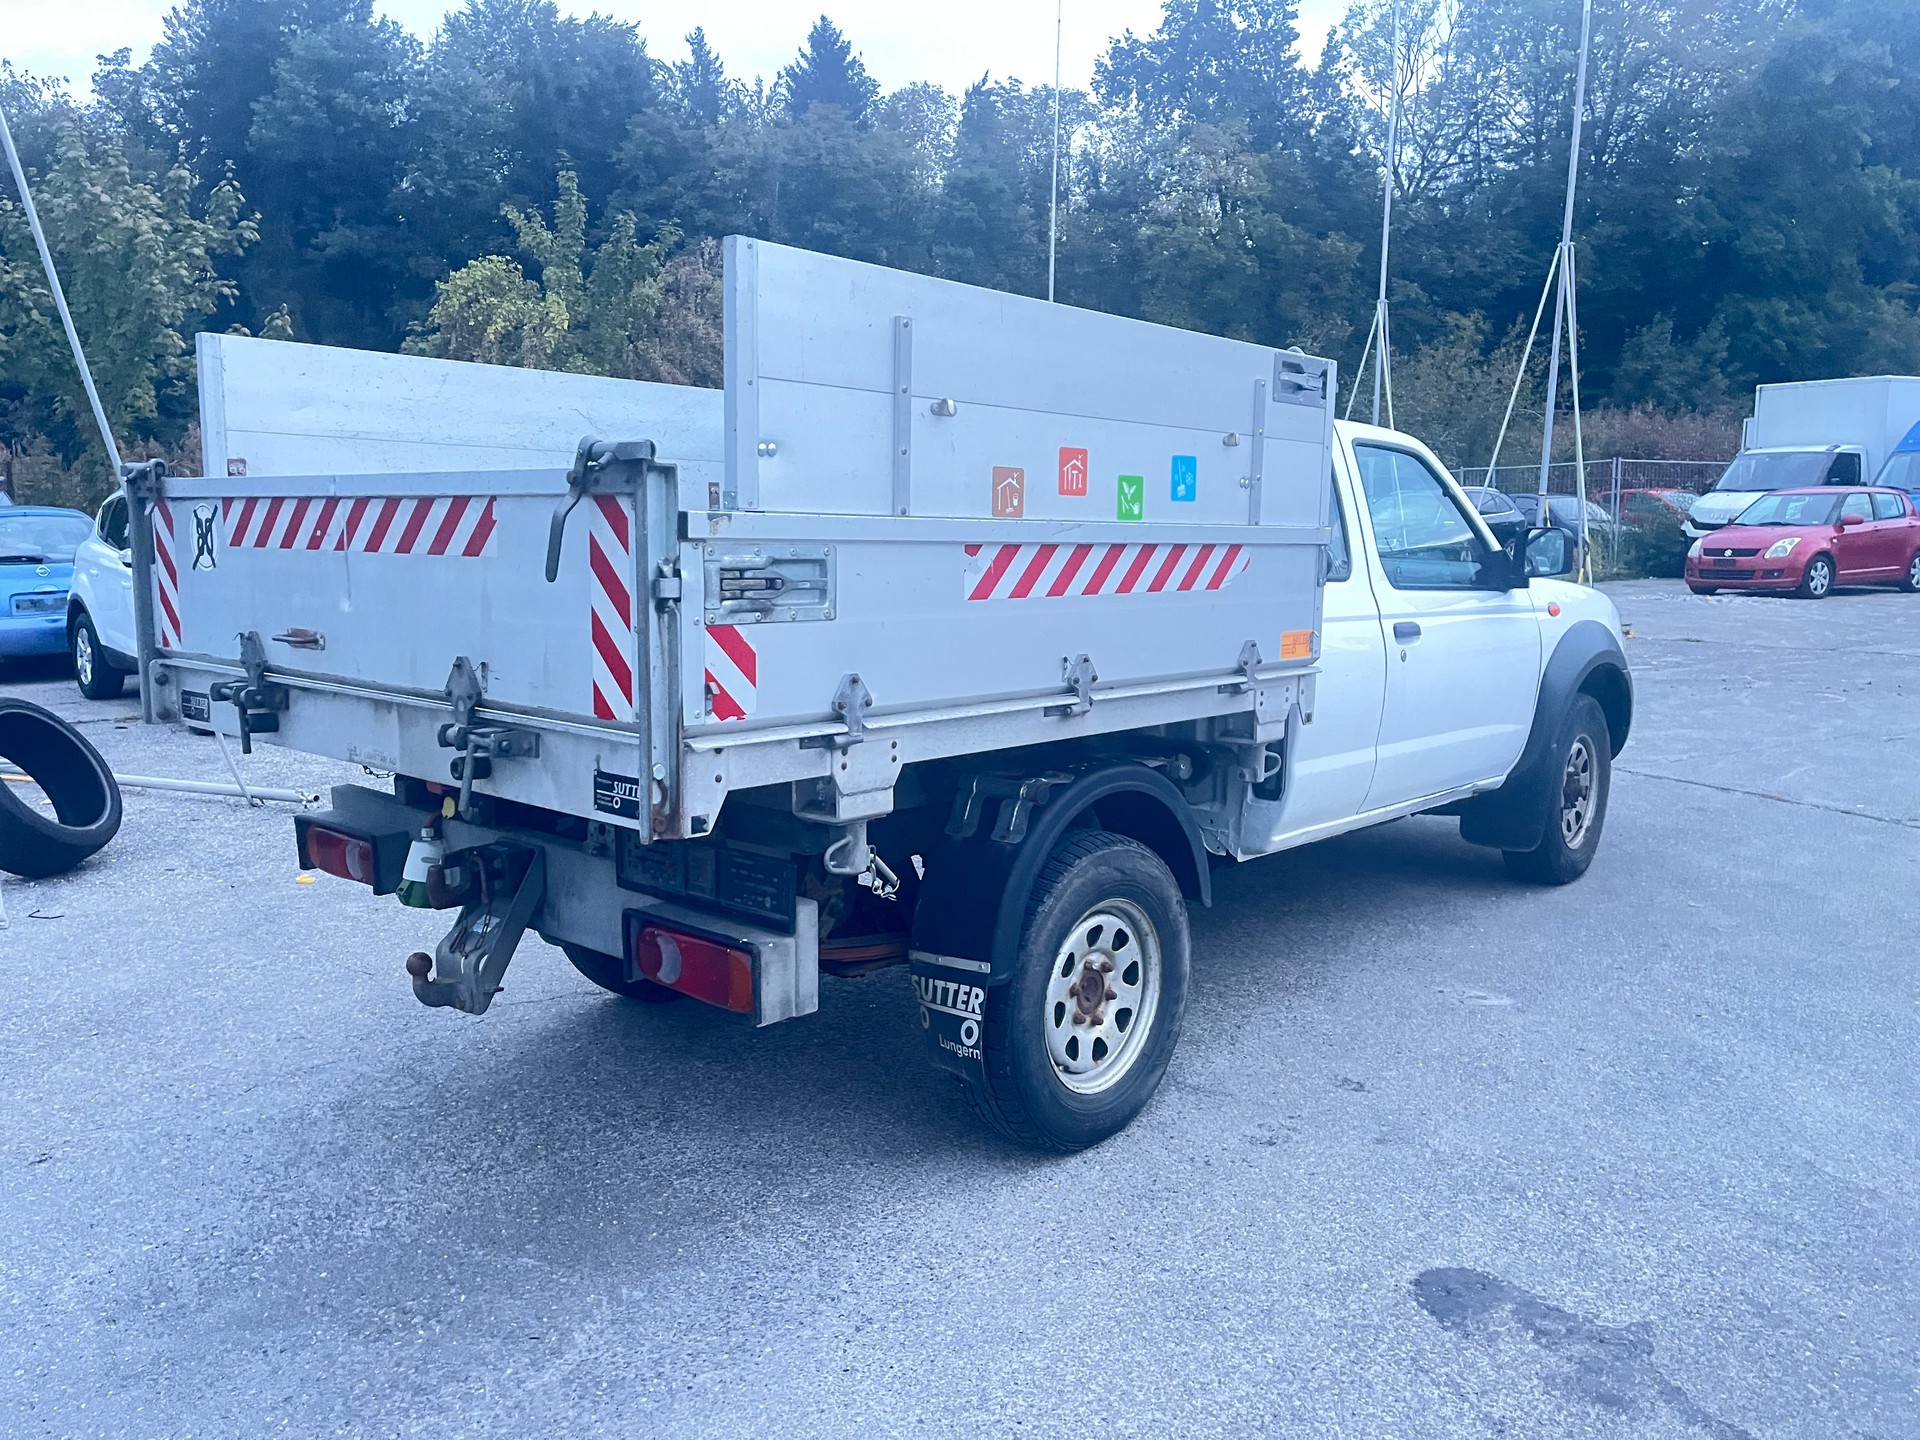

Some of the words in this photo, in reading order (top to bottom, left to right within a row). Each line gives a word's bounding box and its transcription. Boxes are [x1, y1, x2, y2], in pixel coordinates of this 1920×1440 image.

[612, 781, 640, 798] SUTT
[911, 974, 985, 1014] SUTTER
[938, 1033, 981, 1060] Lungern
